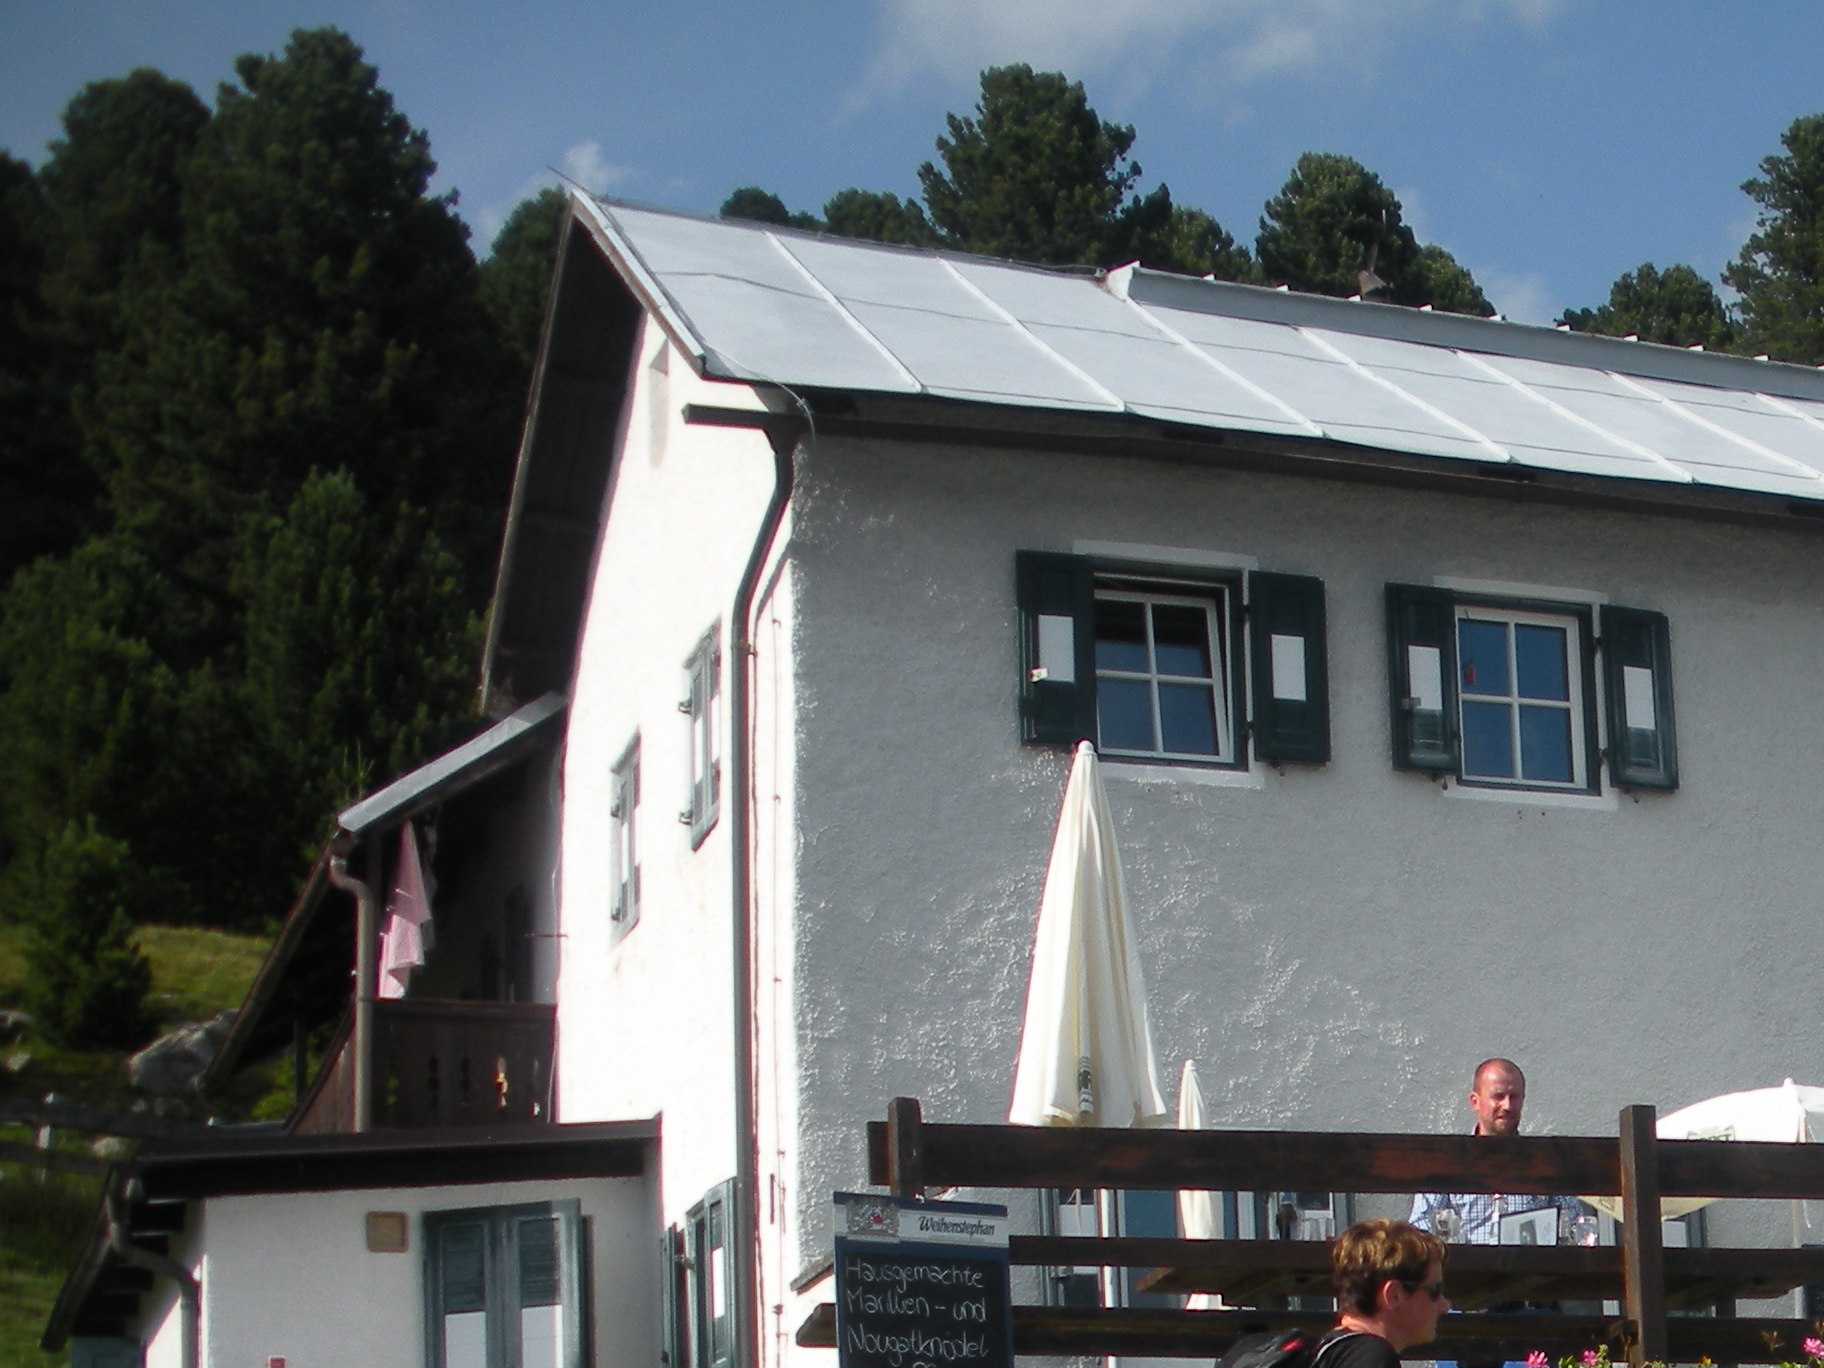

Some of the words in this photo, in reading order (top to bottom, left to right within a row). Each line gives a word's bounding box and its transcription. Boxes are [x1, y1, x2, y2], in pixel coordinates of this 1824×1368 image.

[919, 1211, 995, 1240] Weihenstephan
[846, 1253, 984, 1293] Hausgemachte
[953, 1298, 987, 1322] und
